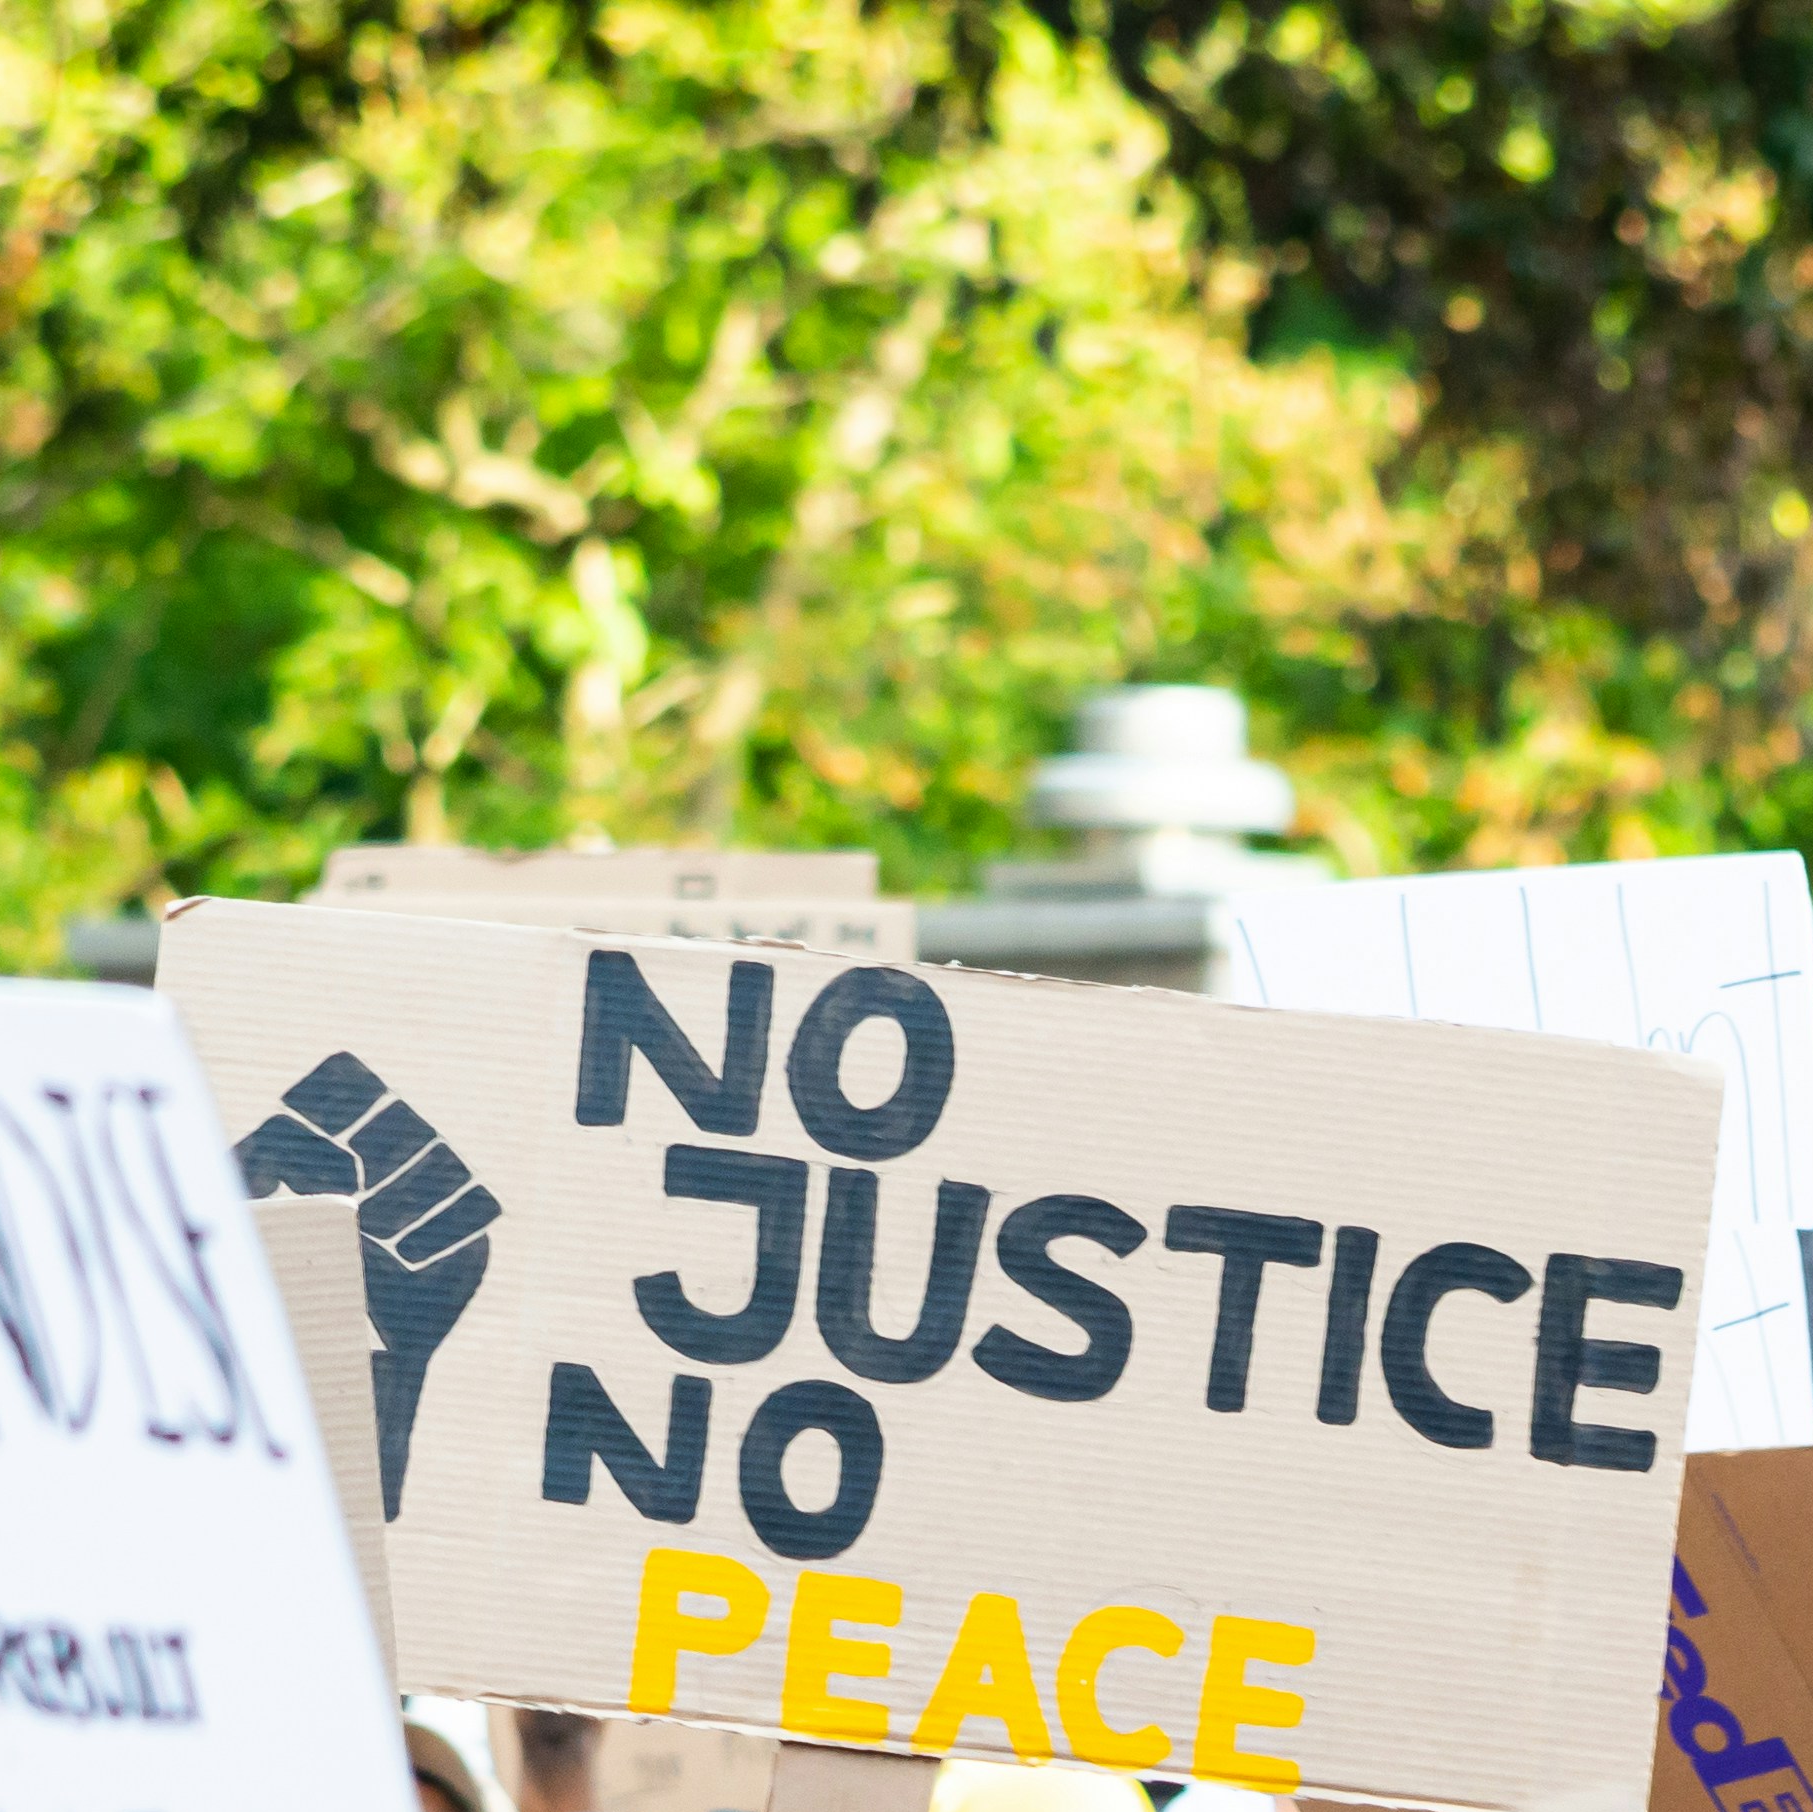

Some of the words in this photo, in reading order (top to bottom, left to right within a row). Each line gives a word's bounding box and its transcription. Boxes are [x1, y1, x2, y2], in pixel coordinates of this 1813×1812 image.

[573, 949, 958, 1163] NO
[631, 1143, 1685, 1475] JUSTICE
[540, 1361, 886, 1561] NO
[626, 1547, 1317, 1794] PEACE
